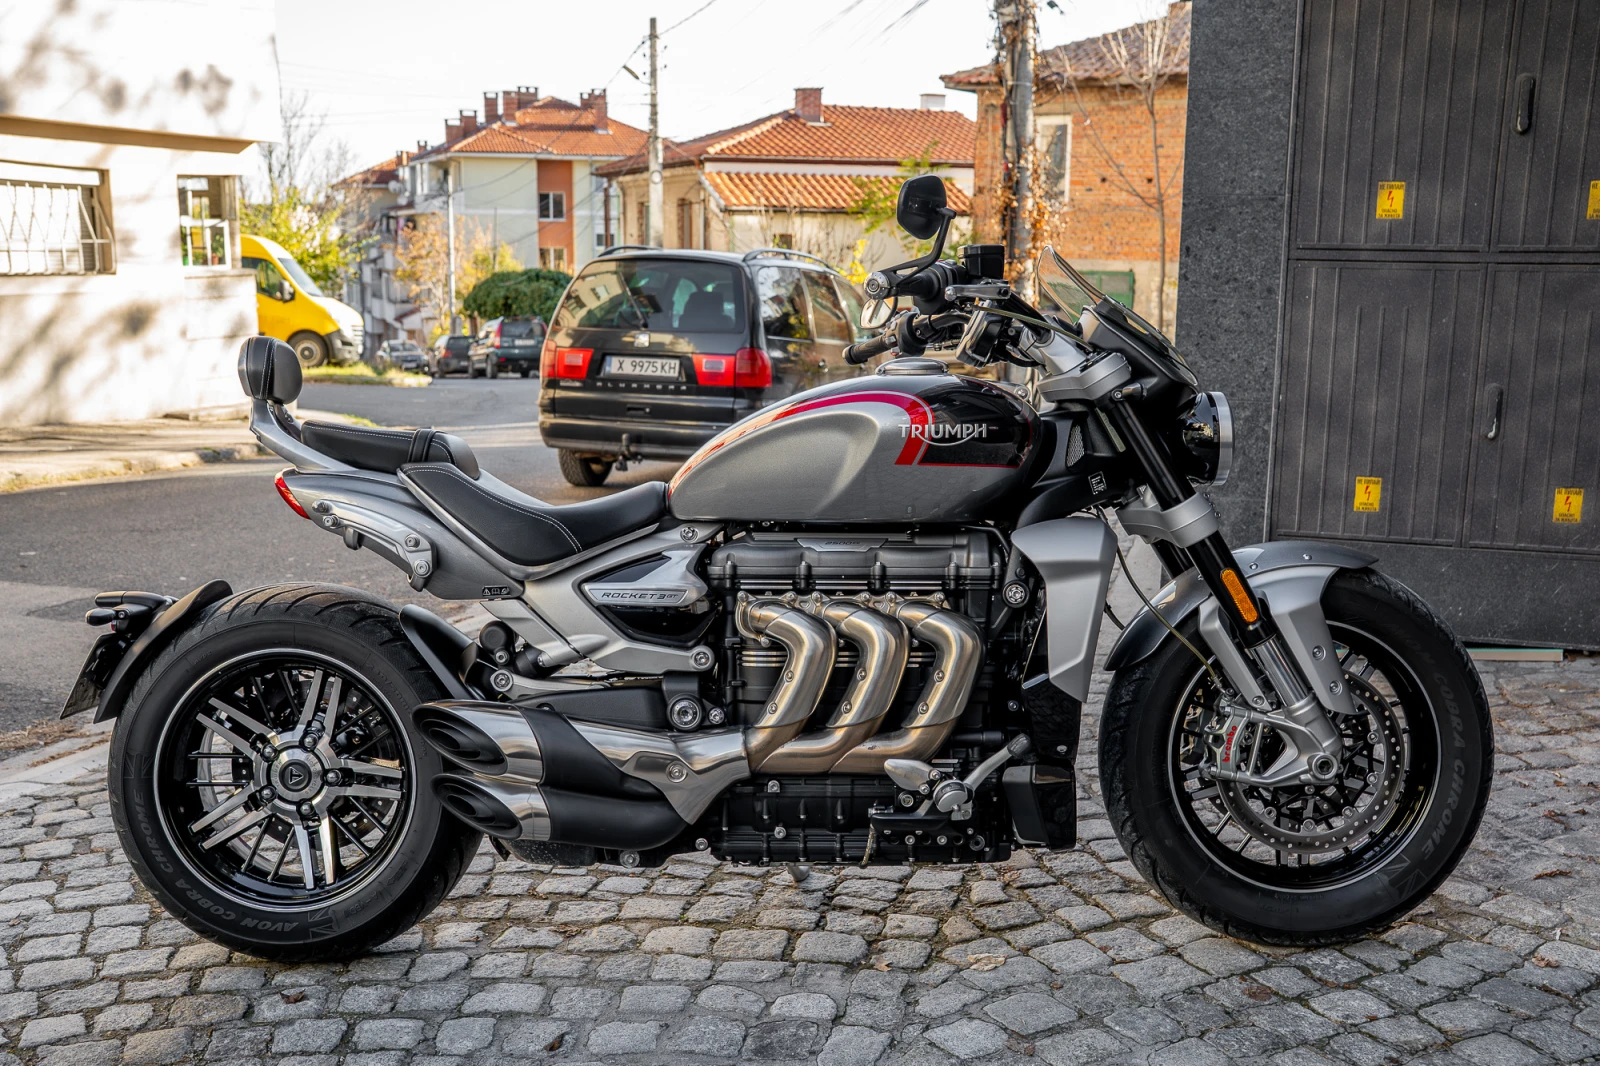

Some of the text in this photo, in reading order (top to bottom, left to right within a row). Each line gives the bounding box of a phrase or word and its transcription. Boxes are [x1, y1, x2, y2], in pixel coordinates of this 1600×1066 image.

[617, 359, 624, 372] X
[630, 361, 657, 373] 9975
[898, 424, 987, 442] TRIUMPH
[1433, 672, 1466, 748] COBRA
[1222, 726, 1237, 762] brembo
[1422, 759, 1465, 860] CHROME
[134, 788, 300, 932] AVON COBRA CHROME
